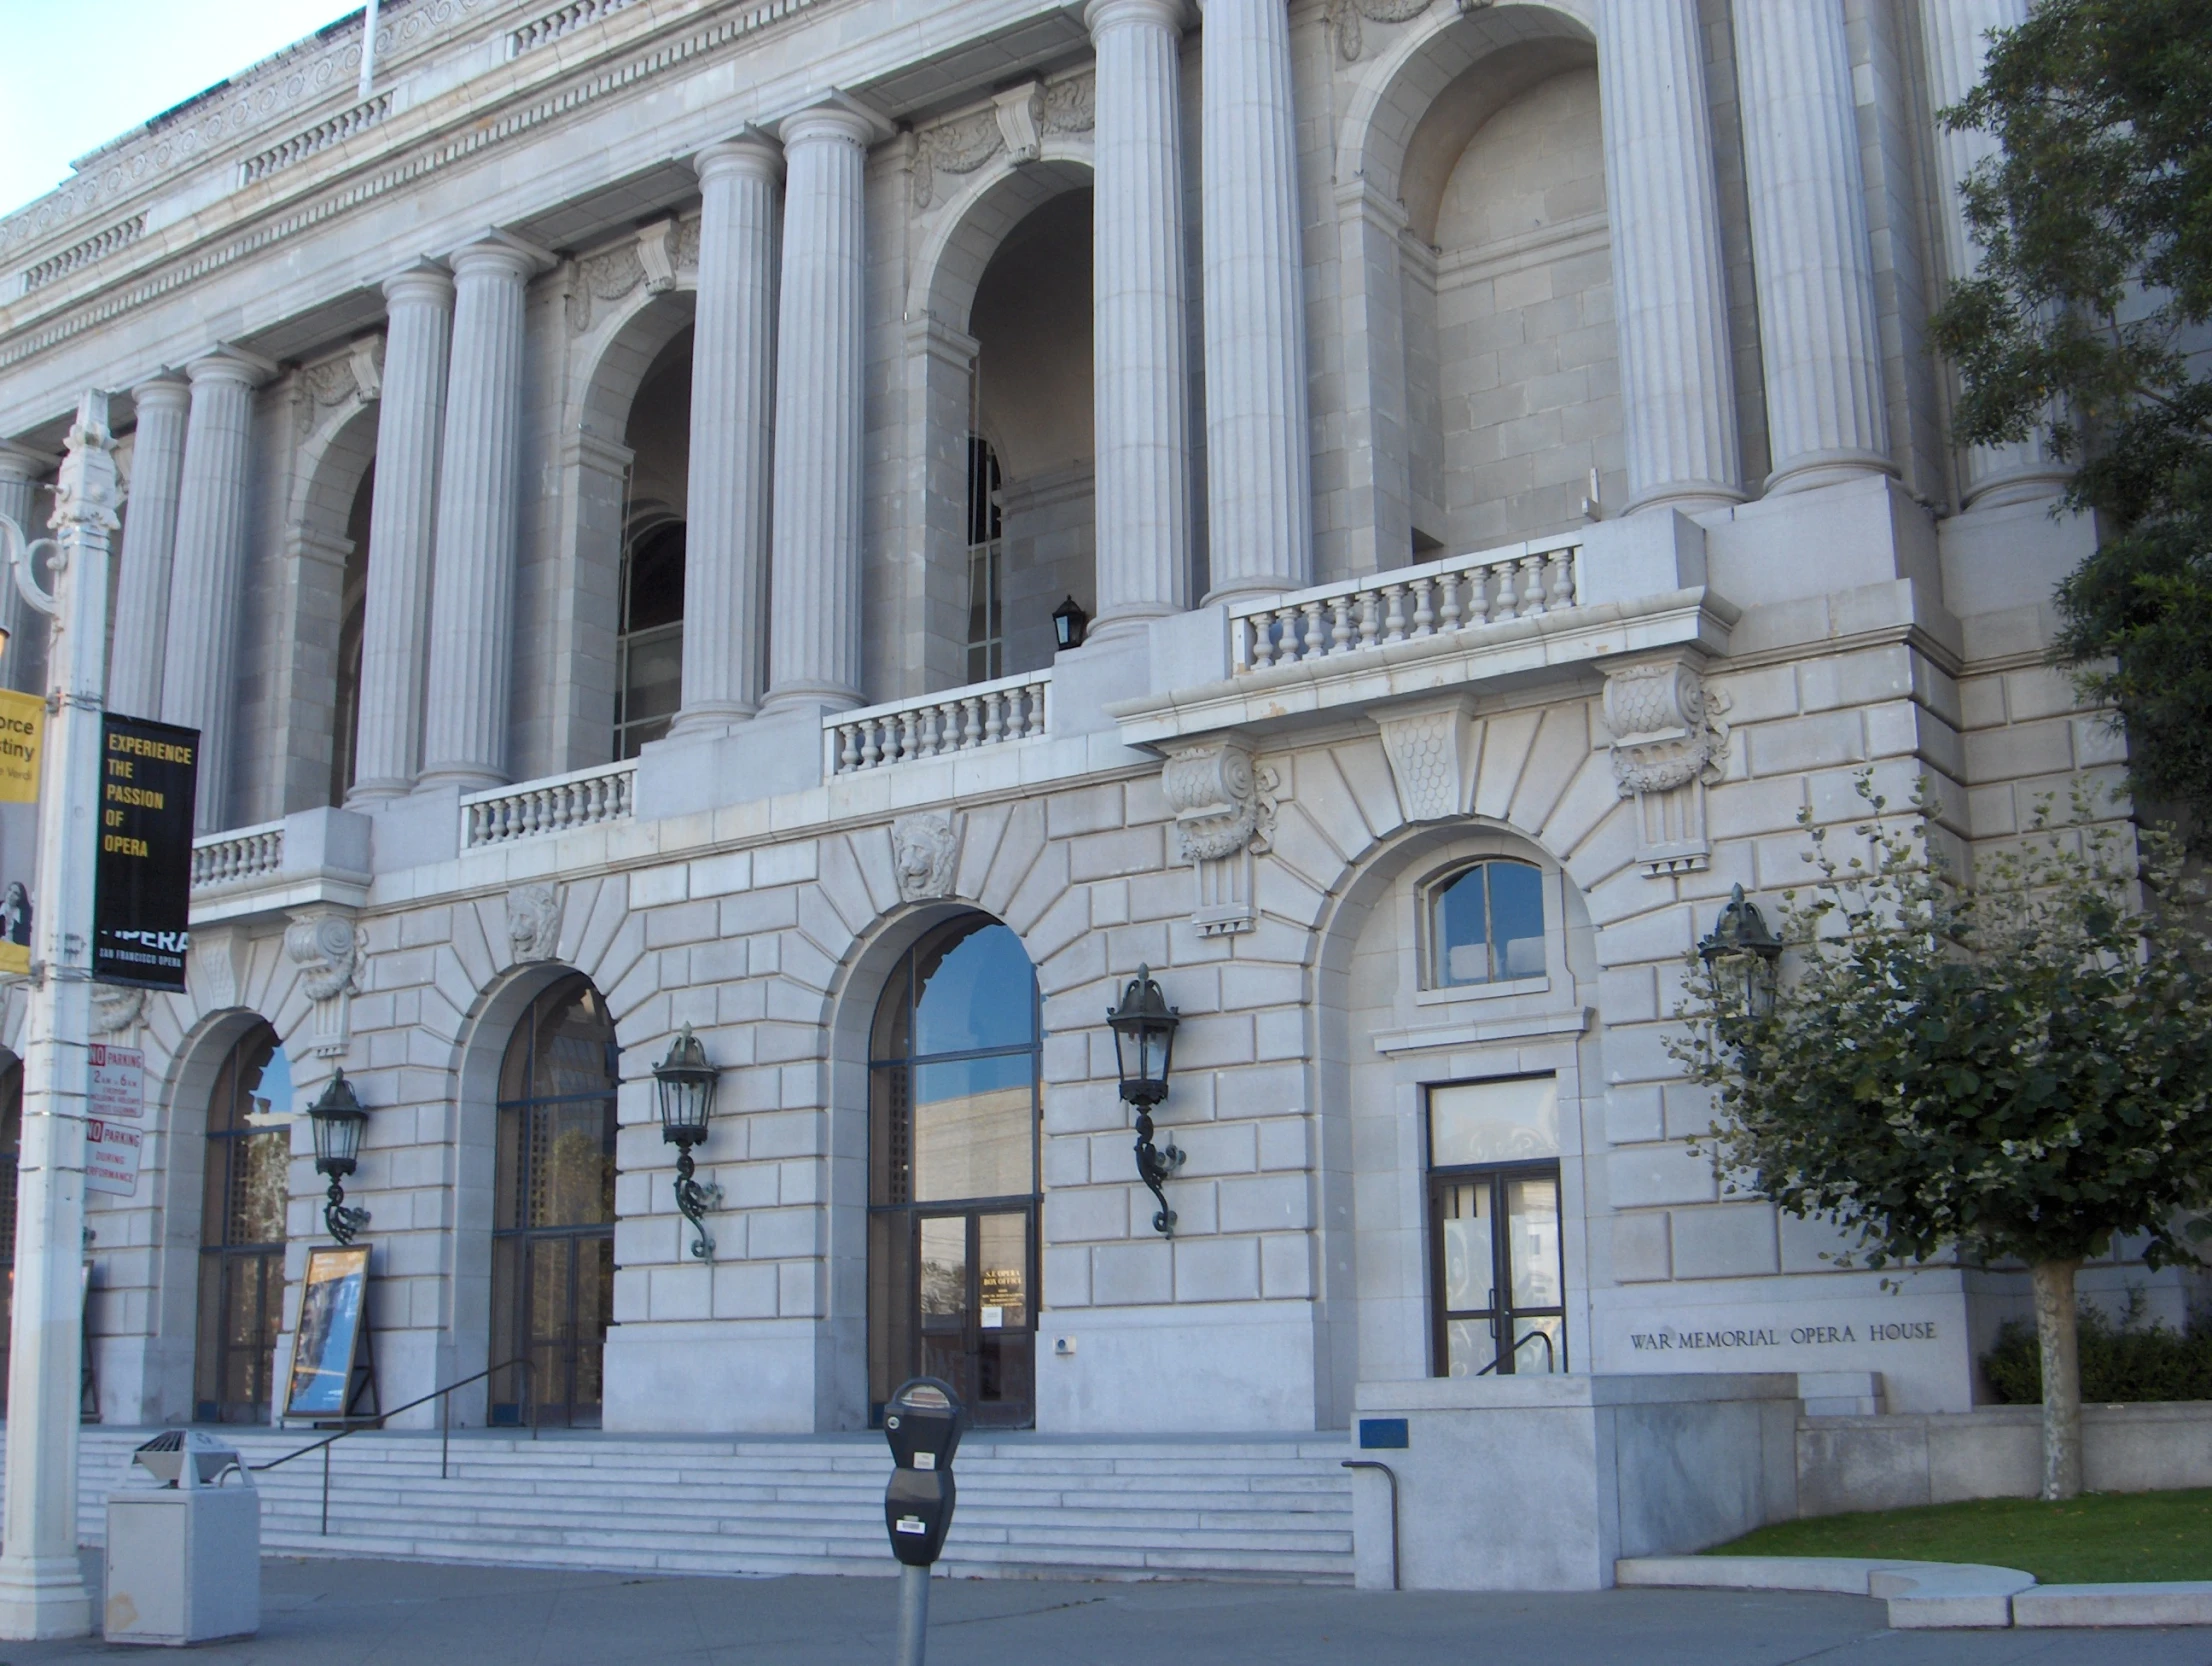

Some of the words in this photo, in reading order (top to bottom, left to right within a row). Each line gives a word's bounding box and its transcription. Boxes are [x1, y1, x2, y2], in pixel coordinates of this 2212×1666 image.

[0, 716, 34, 735] orce
[0, 738, 35, 762] tiny
[109, 733, 192, 765] EXPERIENCE
[108, 758, 133, 779] THE
[106, 784, 163, 810] PASSION
[106, 809, 124, 828] OF
[105, 834, 148, 858] OPERA
[99, 948, 114, 959] SAN
[116, 949, 156, 965] FRANCISCO
[159, 955, 181, 967] OPERA
[107, 1052, 141, 1068] PARKING
[94, 1070, 101, 1083] 2
[120, 1074, 127, 1086] 6
[104, 1128, 140, 1147] PARKING
[96, 1151, 125, 1165] DURING
[86, 1165, 134, 1183] ERFORMANCE
[1631, 1333, 1672, 1350] WAR
[1679, 1328, 1780, 1349] MEMORIAL
[1791, 1325, 1856, 1344] OPERA
[1870, 1321, 1937, 1342] HOUSE
